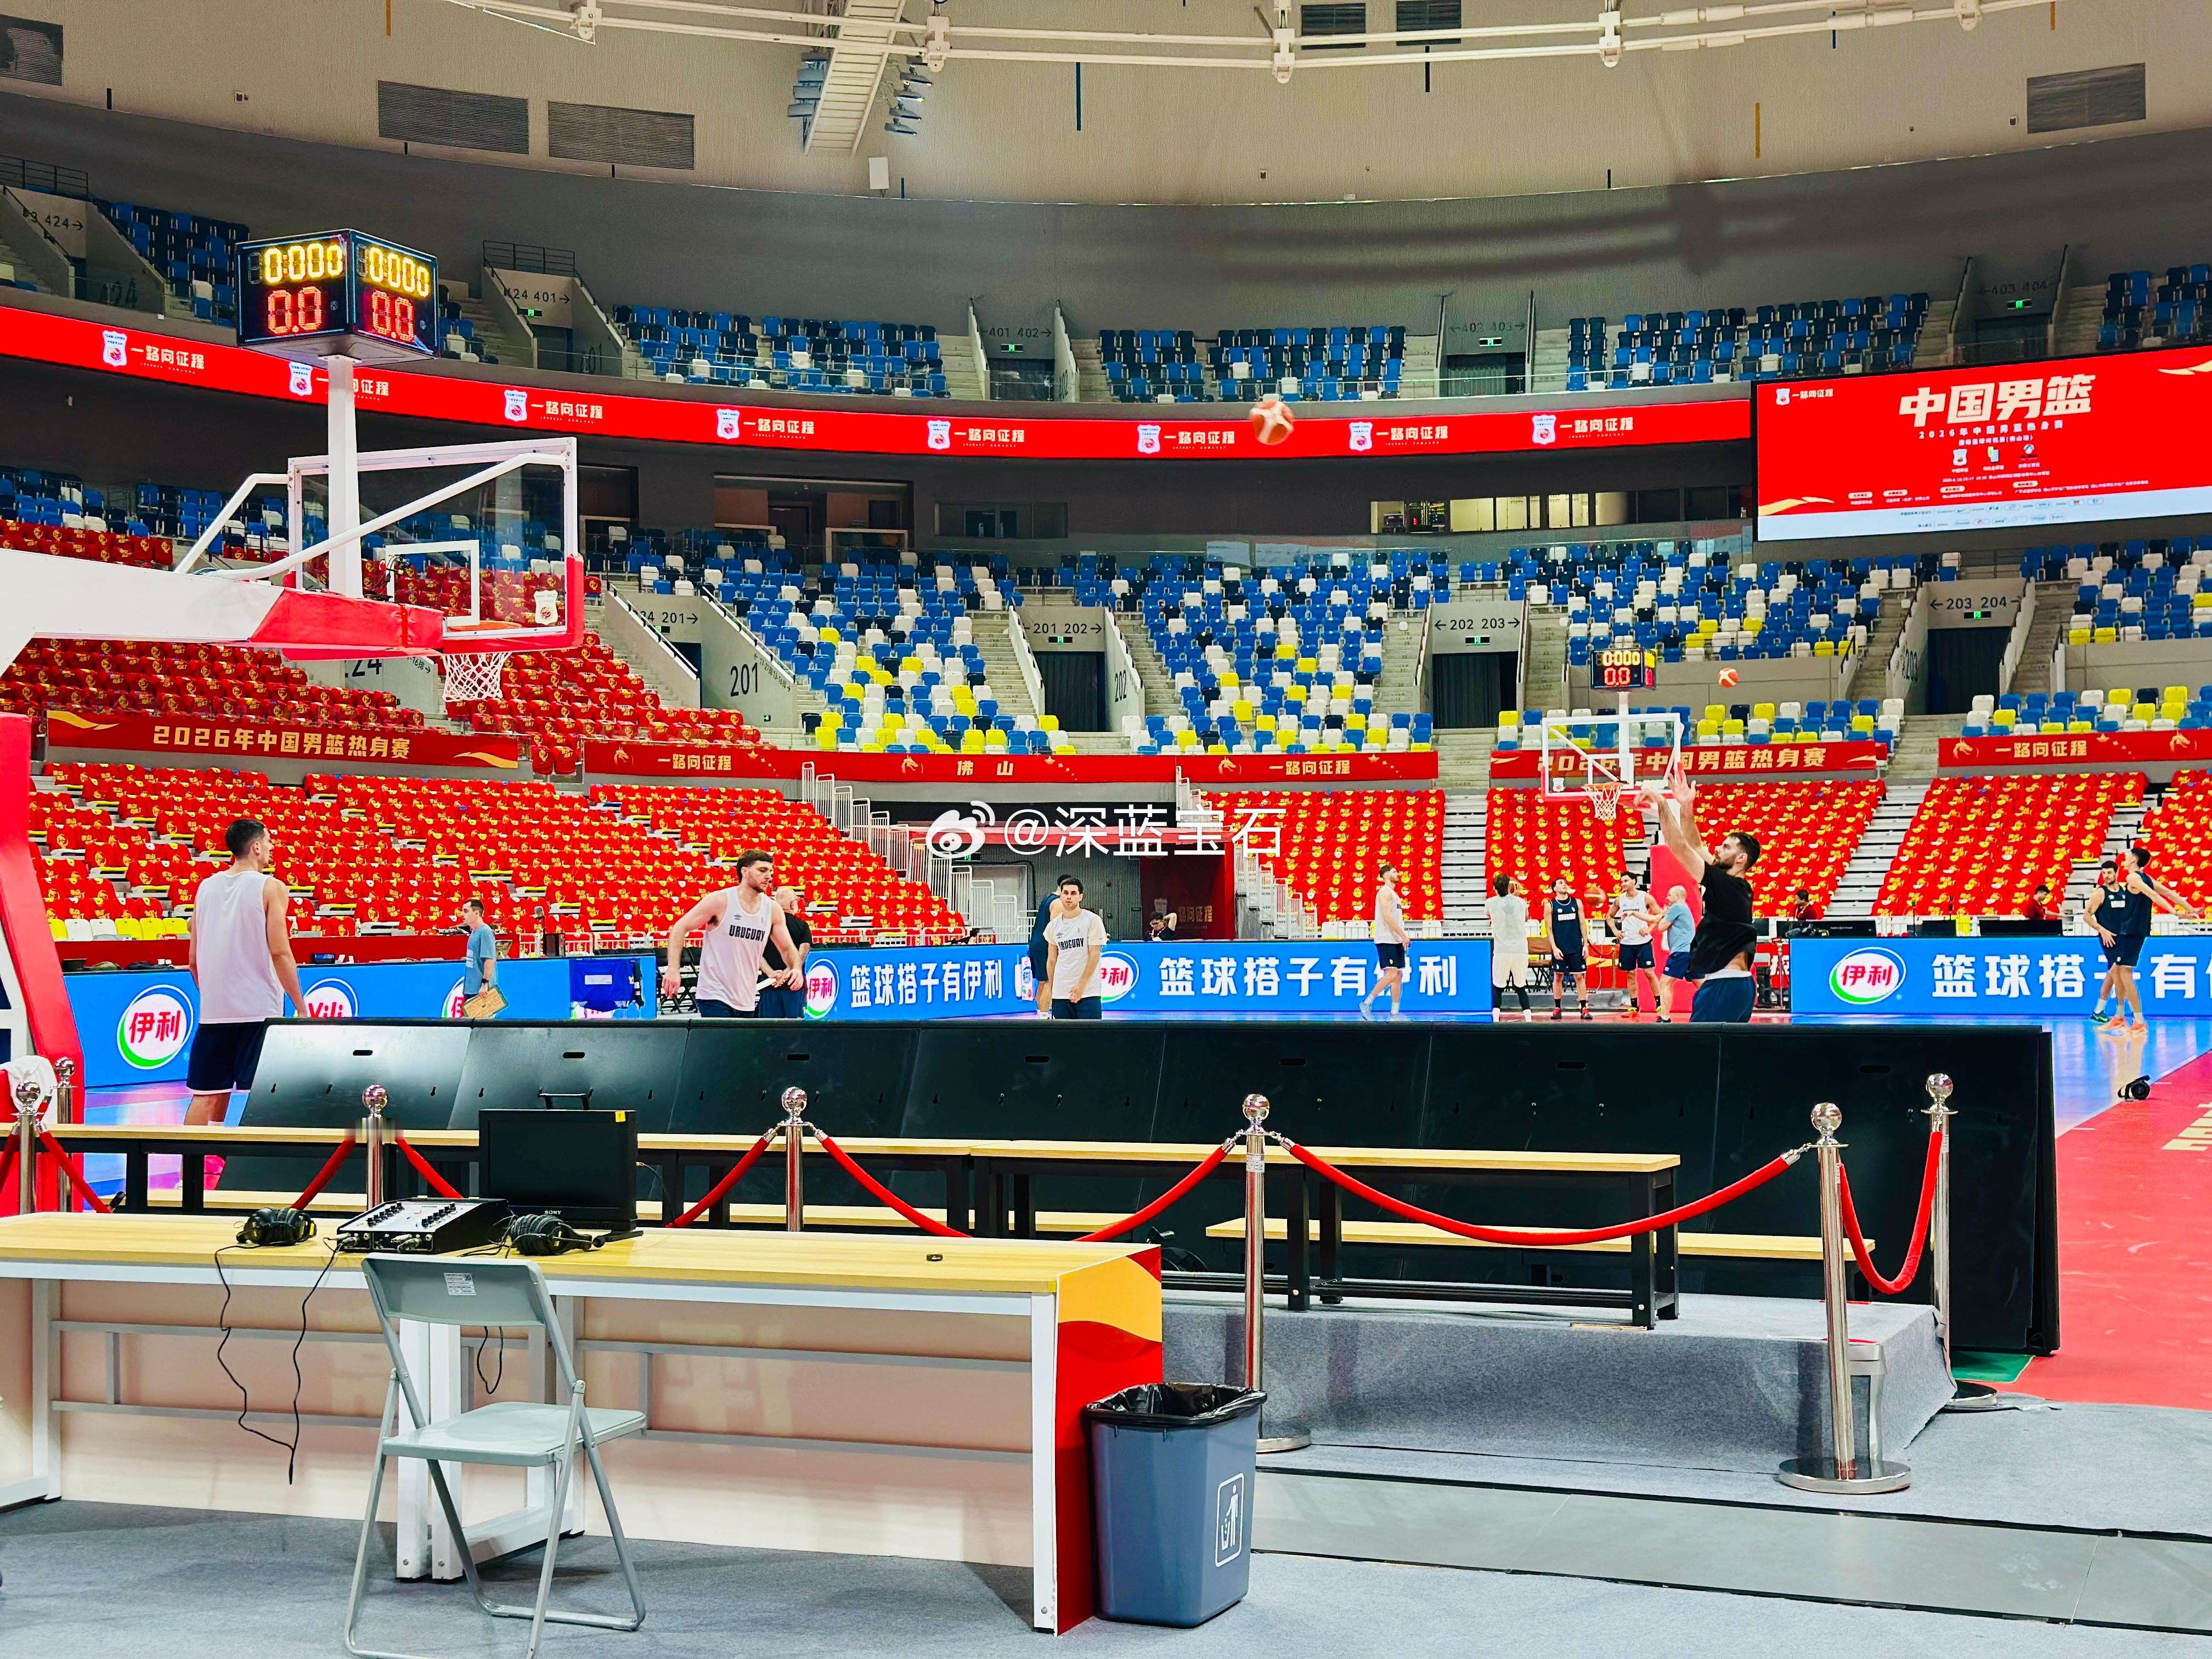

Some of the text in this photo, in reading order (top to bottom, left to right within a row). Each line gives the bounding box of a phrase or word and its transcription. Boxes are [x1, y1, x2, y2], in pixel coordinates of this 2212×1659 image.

[46, 215, 69, 229] 424
[534, 291, 555, 303] 401
[989, 327, 1039, 338] 401 402
[131, 345, 205, 370] 一路向征程
[531, 400, 603, 419] 一路向征程
[1899, 374, 2096, 427] 中国男篮
[743, 418, 815, 435] 一路向征程
[1376, 425, 1448, 441] 一路向征程
[1560, 416, 1633, 433] 一路向征程
[953, 428, 1025, 443] 一路向征程
[1164, 431, 1235, 444] 一路向征程
[1946, 596, 2007, 610] 203 204
[662, 612, 684, 623] 201
[1450, 618, 1505, 630] 202 203
[1034, 623, 1087, 634] 201 202
[730, 662, 758, 697] 201
[1115, 670, 1127, 703] 202
[154, 725, 410, 759] 2026年中国男篮热身赛
[1995, 740, 2087, 759] 一路向征程
[658, 753, 731, 771] 一路向征程
[1269, 759, 1350, 775] 一路向征程
[729, 924, 766, 942] URUGUAY
[851, 959, 1003, 1008] 篮球搭子有伊利
[1841, 964, 1893, 987] 伊利
[1932, 953, 2212, 1000] 篮球搭有
[808, 977, 833, 1001] 伊利
[128, 1009, 181, 1043] 伊利
